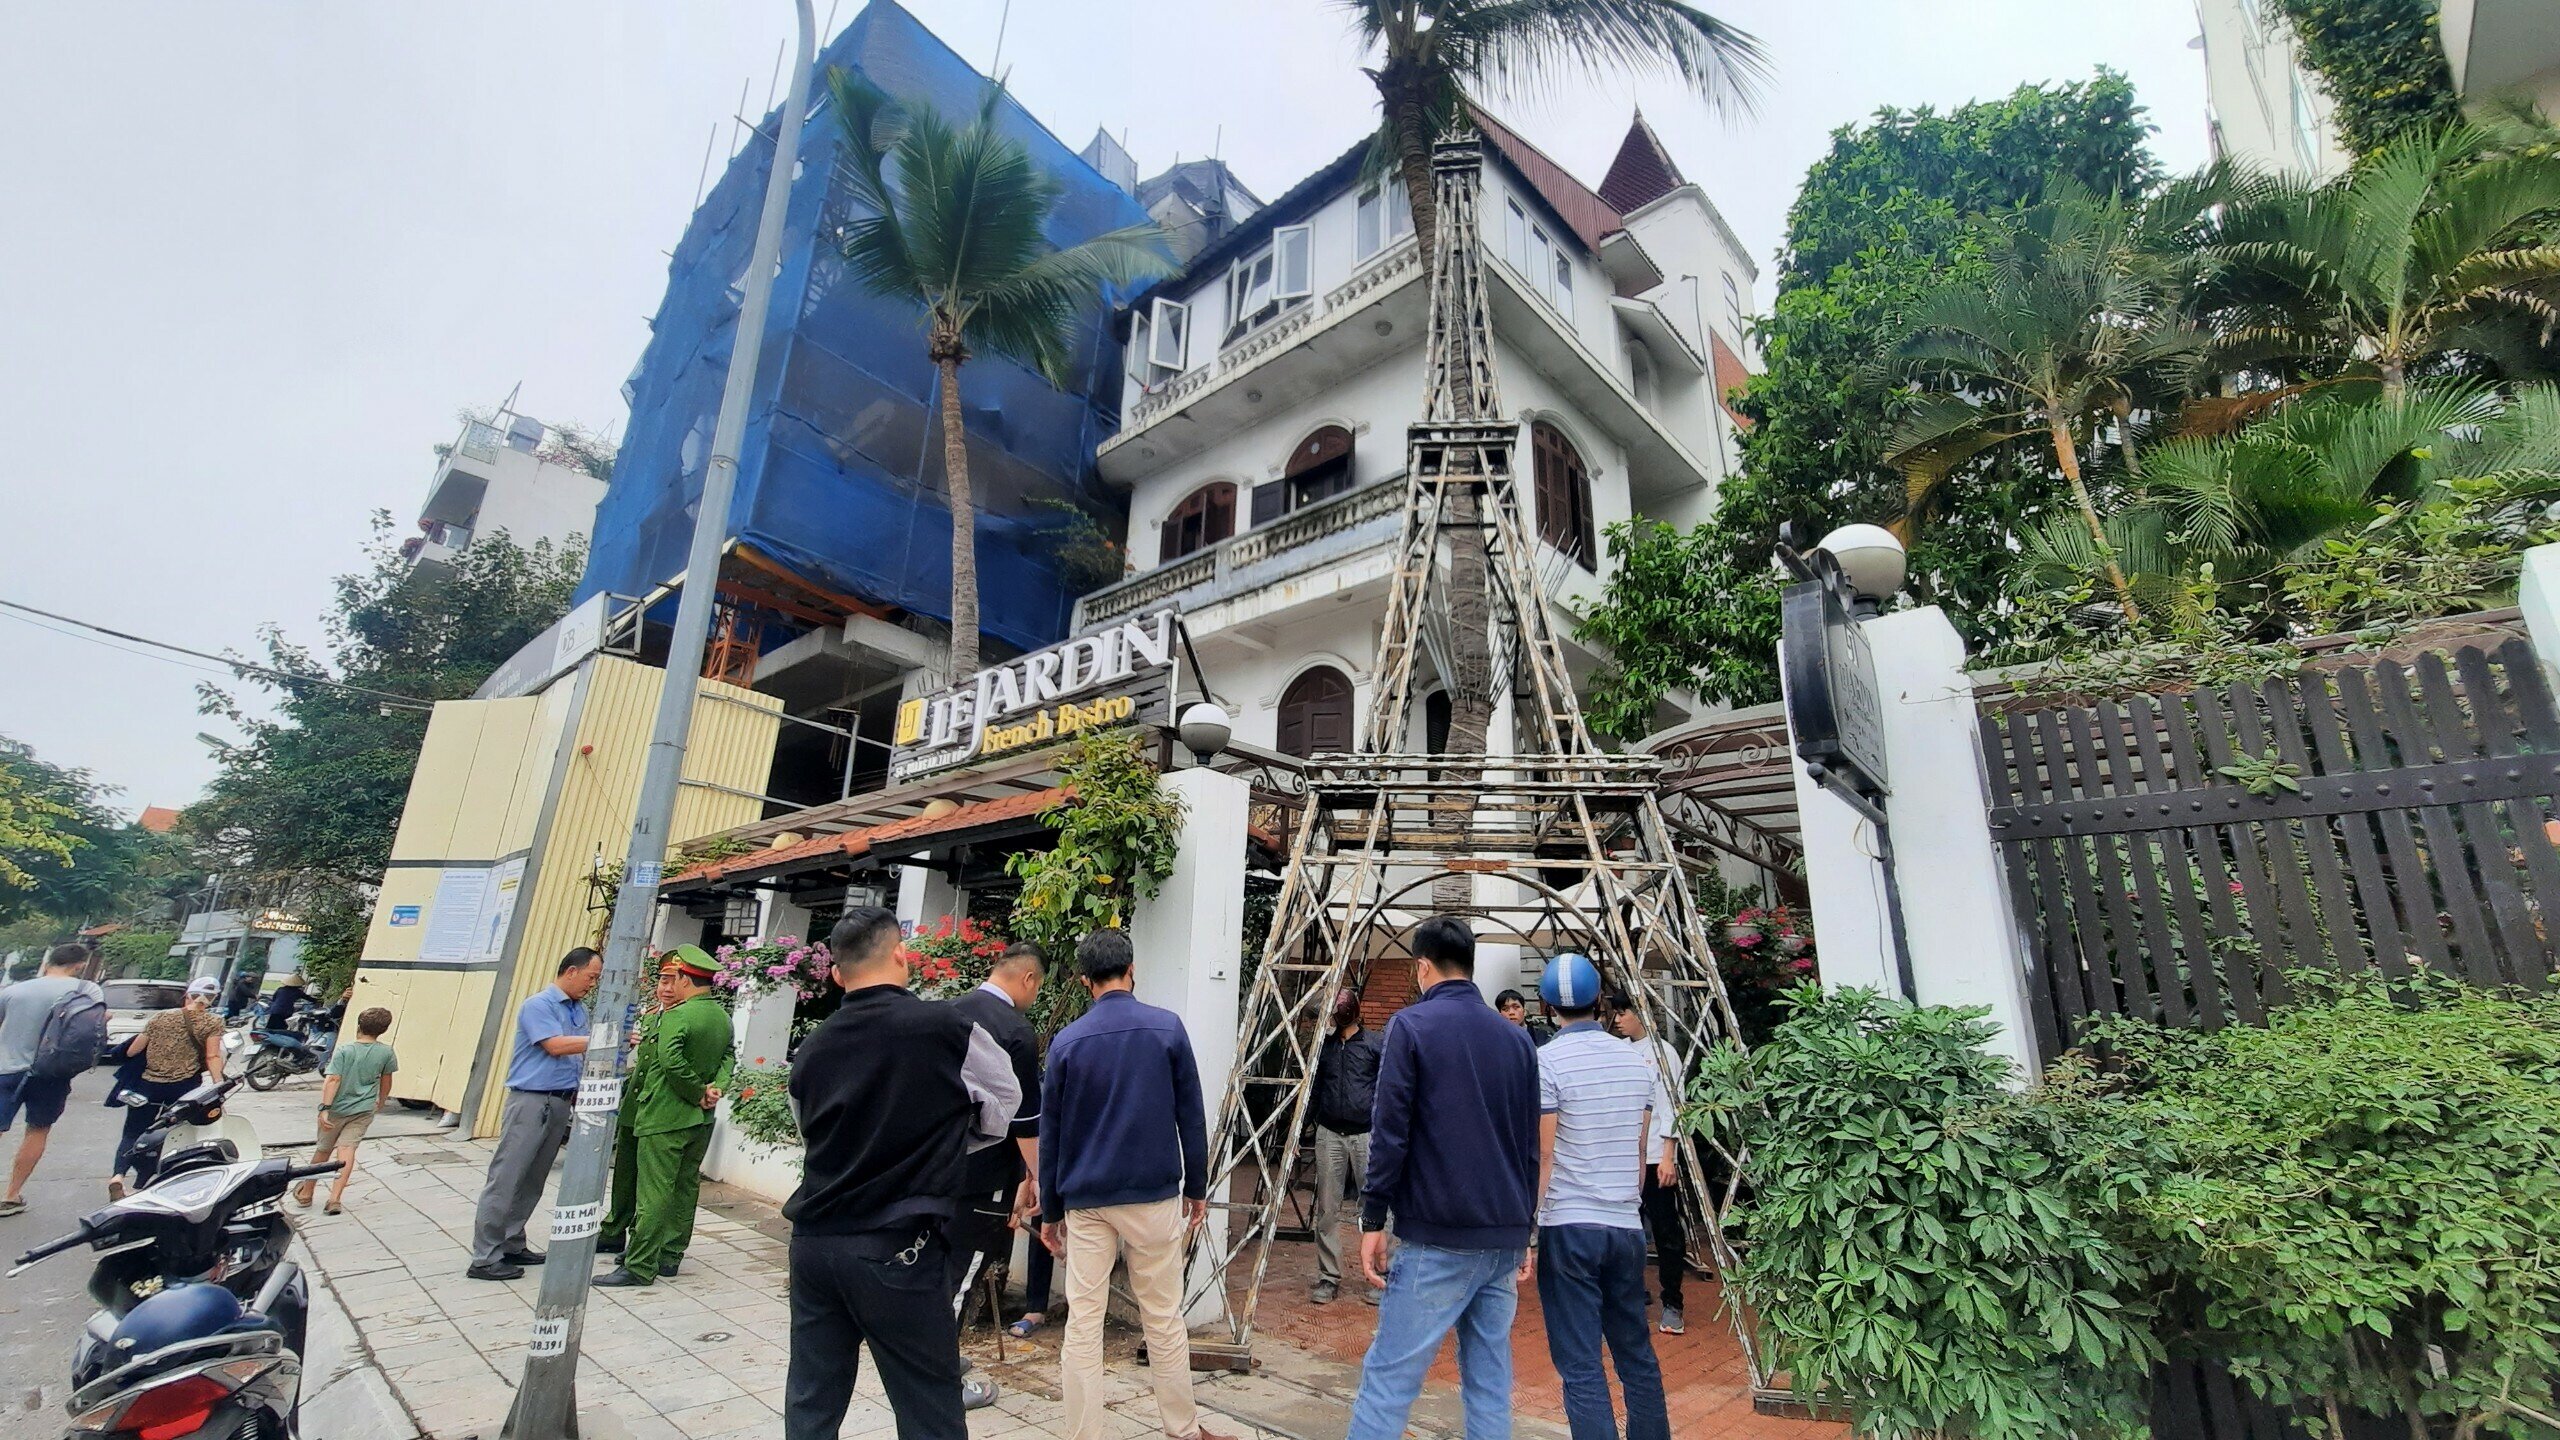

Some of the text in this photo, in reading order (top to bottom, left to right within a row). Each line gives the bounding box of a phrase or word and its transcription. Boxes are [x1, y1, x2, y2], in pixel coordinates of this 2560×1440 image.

[926, 690, 976, 748] LE
[961, 608, 1175, 758] JARDIN
[980, 695, 1136, 754] French Bistro
